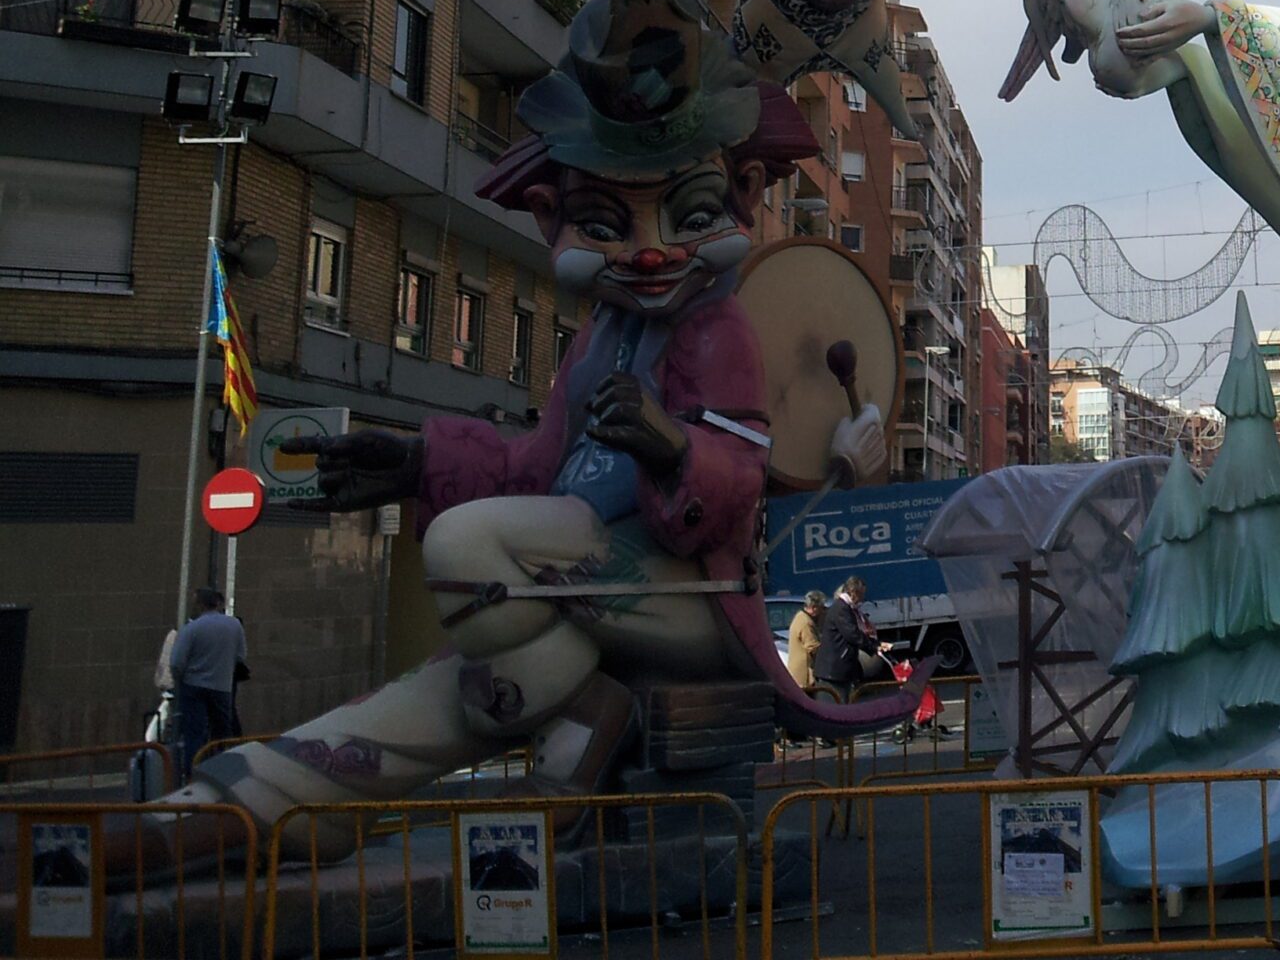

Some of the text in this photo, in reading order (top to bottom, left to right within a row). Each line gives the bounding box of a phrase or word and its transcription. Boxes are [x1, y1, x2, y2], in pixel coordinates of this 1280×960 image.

[850, 496, 945, 513] DISTRIBUIDOR OFICIAL
[804, 521, 891, 548] Roca
